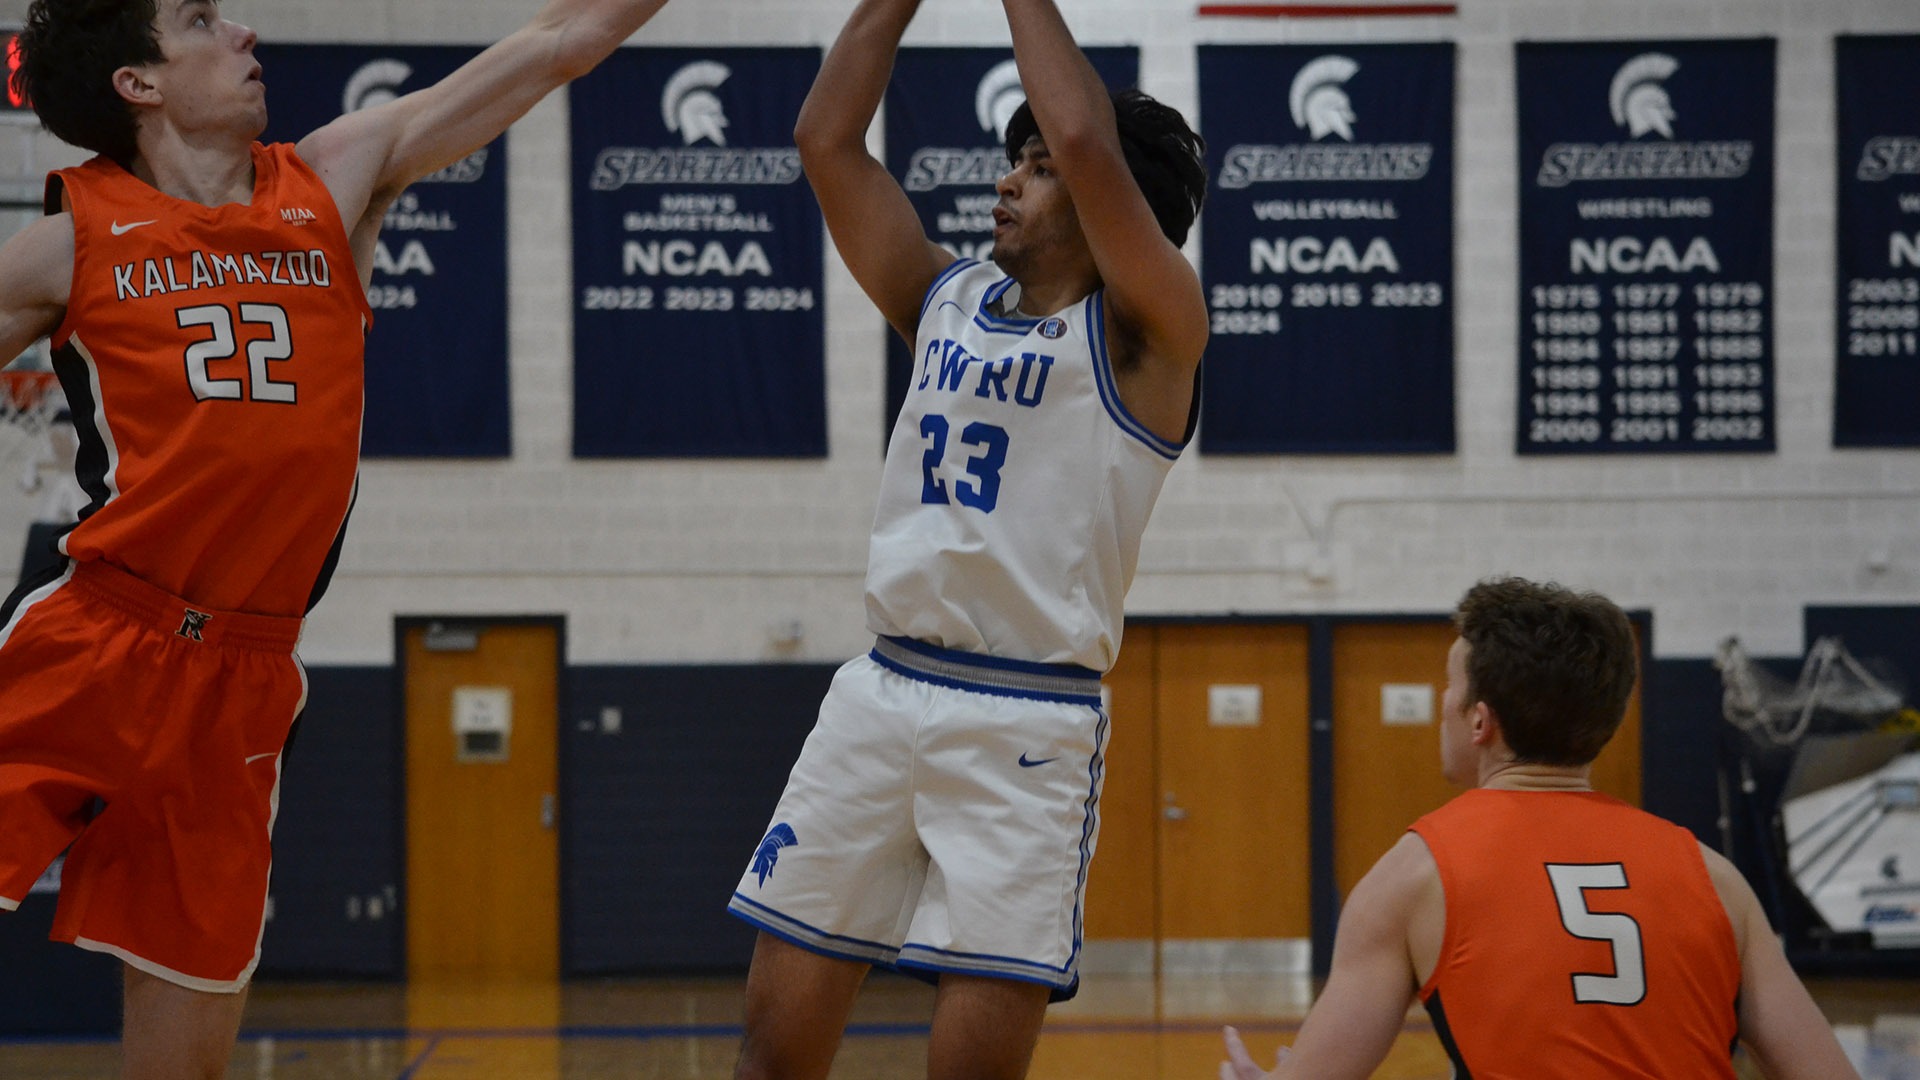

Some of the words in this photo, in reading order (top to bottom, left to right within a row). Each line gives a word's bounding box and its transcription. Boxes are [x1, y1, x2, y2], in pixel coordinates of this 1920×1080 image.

[590, 147, 802, 190] SPARTANS
[1218, 143, 1433, 188] SPARTANS
[1537, 142, 1753, 187] SPARTANS
[280, 208, 316, 220] MIAA
[661, 195, 736, 213] MEN'S
[1253, 200, 1397, 220] VOLLEYBALL
[1577, 198, 1712, 218] WRESTLING
[624, 213, 772, 232] BASKETBALL
[624, 241, 772, 276] NCAA
[1251, 237, 1399, 273] NCAA
[1570, 237, 1719, 273] NCAA
[113, 249, 331, 301] KALAMAZOO
[367, 286, 416, 309] 024
[585, 287, 653, 310] 2022
[664, 287, 734, 310] 2023
[746, 288, 814, 310] 2024
[1211, 284, 1282, 308] 2010
[1291, 283, 1361, 306] 2015
[1371, 282, 1442, 306] 2023
[1614, 284, 1680, 307] 1977
[1211, 311, 1281, 334] 2024
[176, 303, 297, 404] 22
[918, 338, 1055, 408] CWRU
[1531, 419, 1600, 441] 2000
[919, 414, 1010, 514] 23
[1544, 862, 1646, 1006] 5
